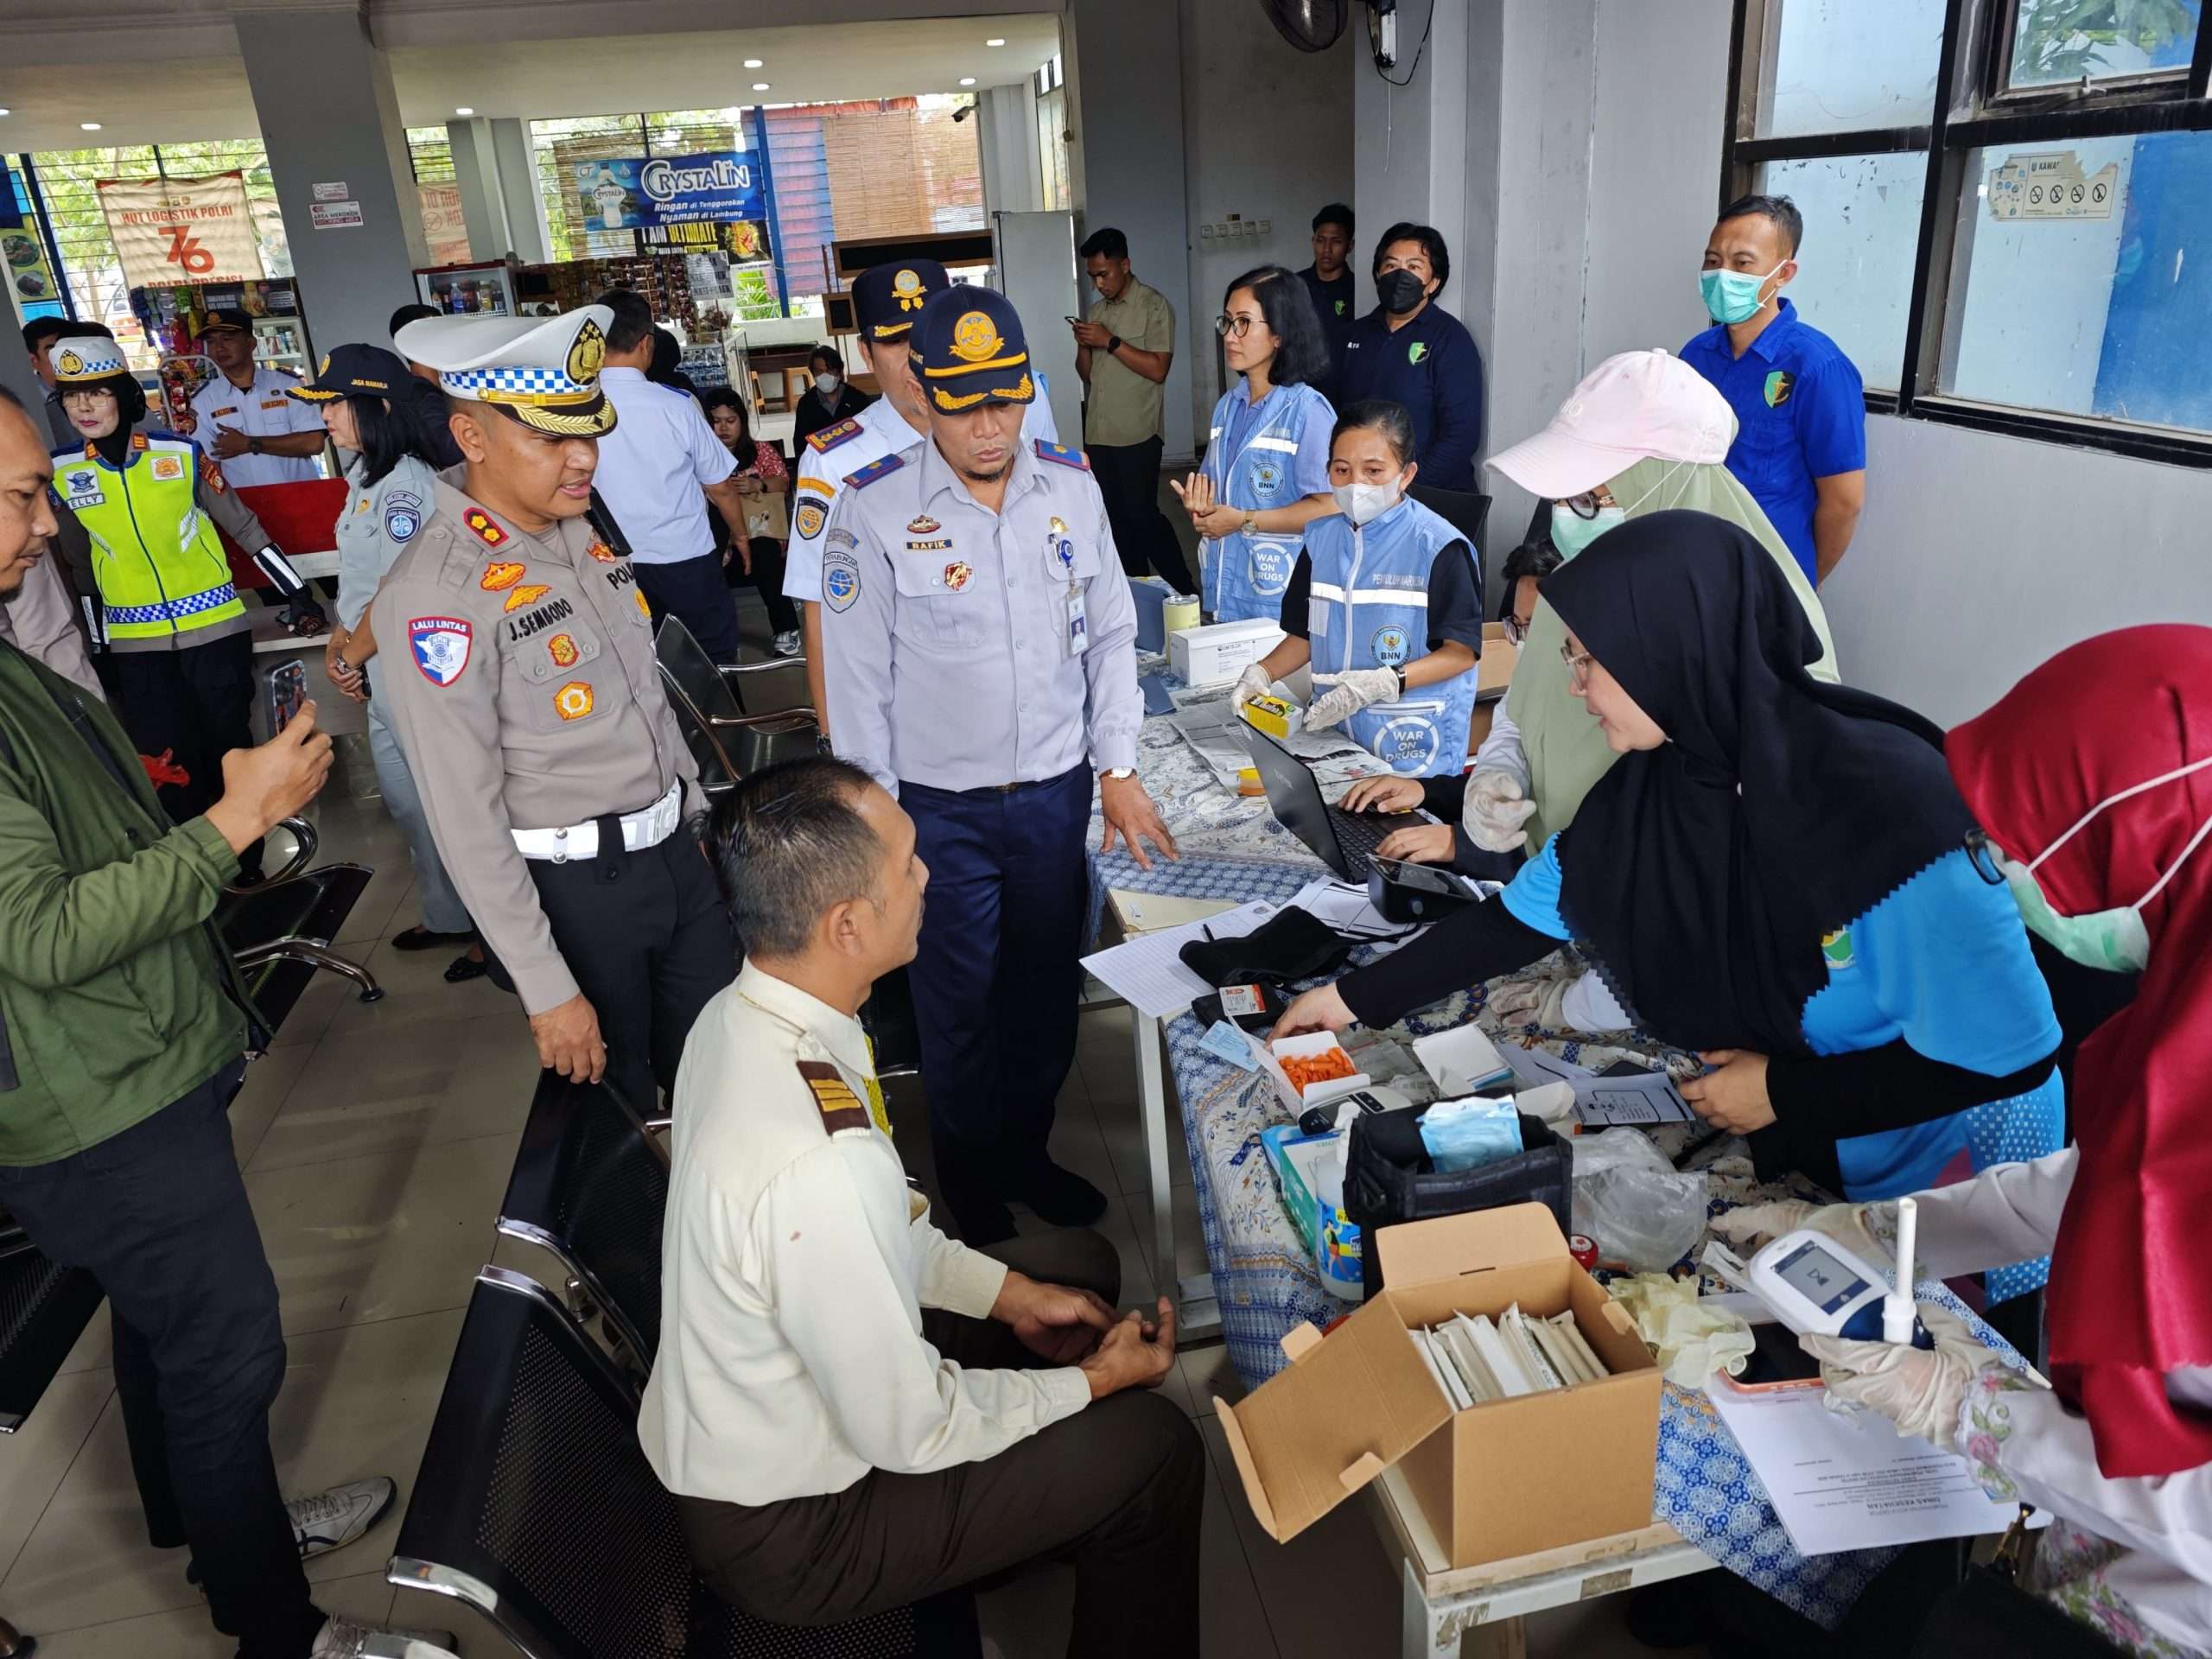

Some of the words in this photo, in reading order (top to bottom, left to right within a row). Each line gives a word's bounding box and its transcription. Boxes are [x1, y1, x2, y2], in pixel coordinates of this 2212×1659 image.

[654, 201, 688, 212] Ringan
[699, 199, 745, 209] Tenggorokan
[122, 212, 145, 225] HUT
[147, 208, 198, 222] LOGISTIK
[200, 206, 233, 218] POLRI
[659, 211, 699, 223] Nyaman
[710, 209, 743, 219] Lambung
[649, 226, 667, 244] AM
[668, 222, 718, 244] ULTIMATE
[157, 225, 215, 274] 76
[912, 540, 946, 550] RAFIK
[1256, 553, 1281, 563] WAR
[1261, 563, 1274, 571] ON
[509, 598, 574, 641] J.SEMBODO
[412, 620, 435, 630] LALU
[436, 620, 467, 632] LINTAS
[1381, 652, 1401, 660] BNN
[1392, 731, 1424, 741] WAR
[1398, 741, 1416, 752] ON
[1385, 748, 1426, 762] DRUGS
